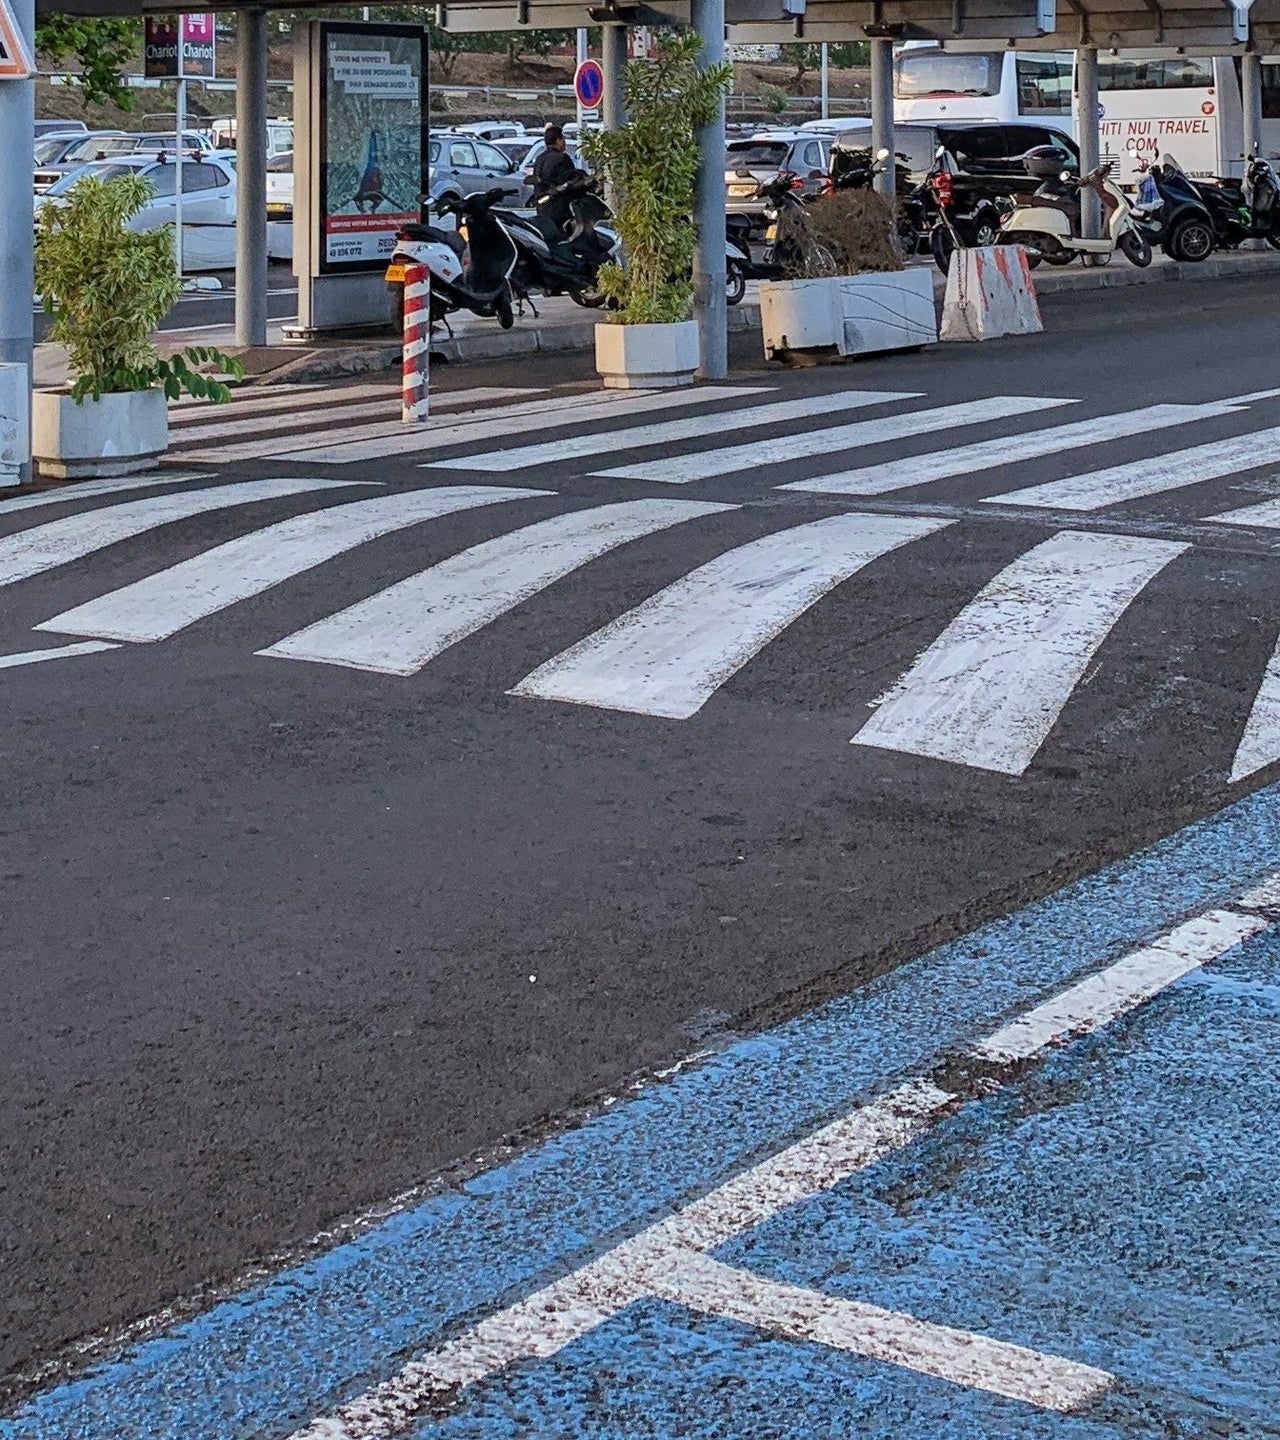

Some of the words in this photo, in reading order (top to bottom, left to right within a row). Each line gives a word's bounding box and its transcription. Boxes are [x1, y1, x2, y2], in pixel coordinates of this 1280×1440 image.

[146, 44, 178, 58] Chariot
[183, 43, 213, 59] Chariot
[1098, 122, 1122, 136] HITI
[1128, 121, 1151, 136] NUI
[1157, 120, 1209, 135] TRAVEL
[1121, 137, 1158, 152] .COM
